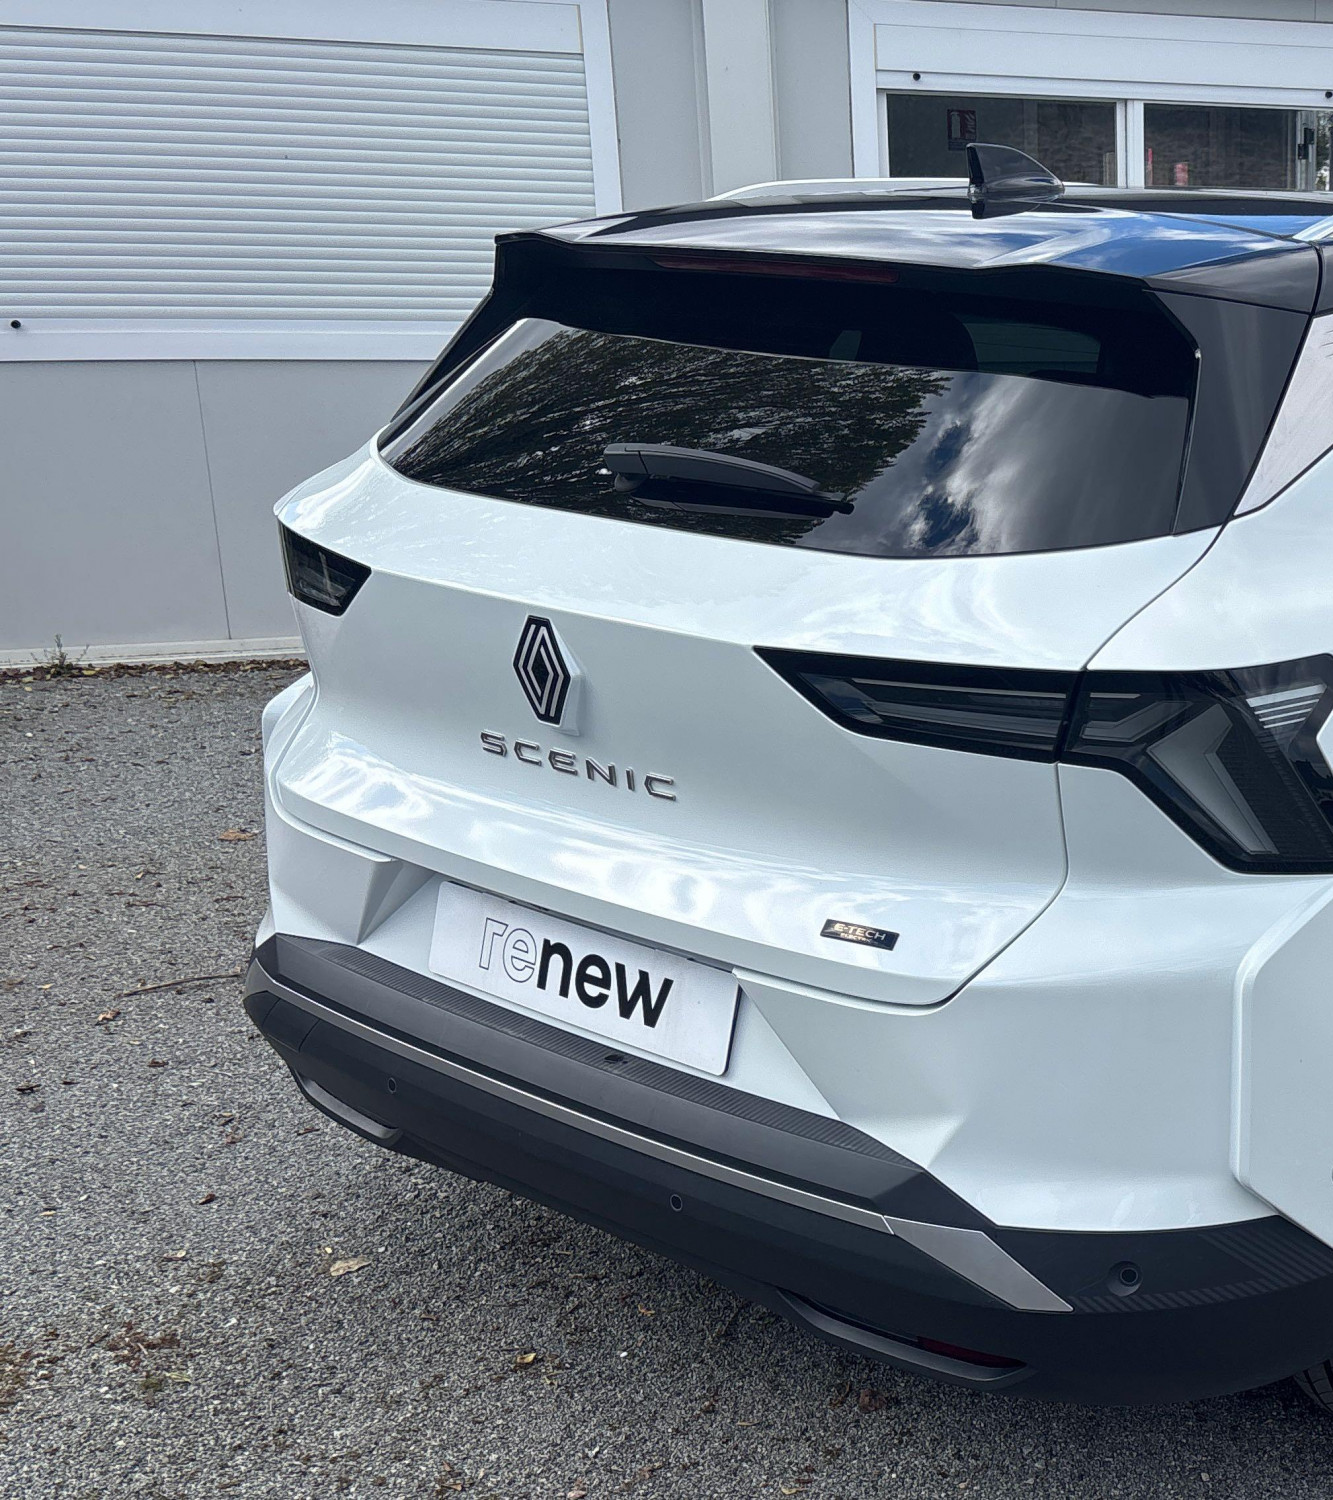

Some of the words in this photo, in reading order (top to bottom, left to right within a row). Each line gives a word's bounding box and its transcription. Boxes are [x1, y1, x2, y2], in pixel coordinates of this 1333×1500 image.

[480, 729, 677, 801] SCENIC
[833, 922, 887, 941] E-TECH
[478, 917, 675, 1029] renew
